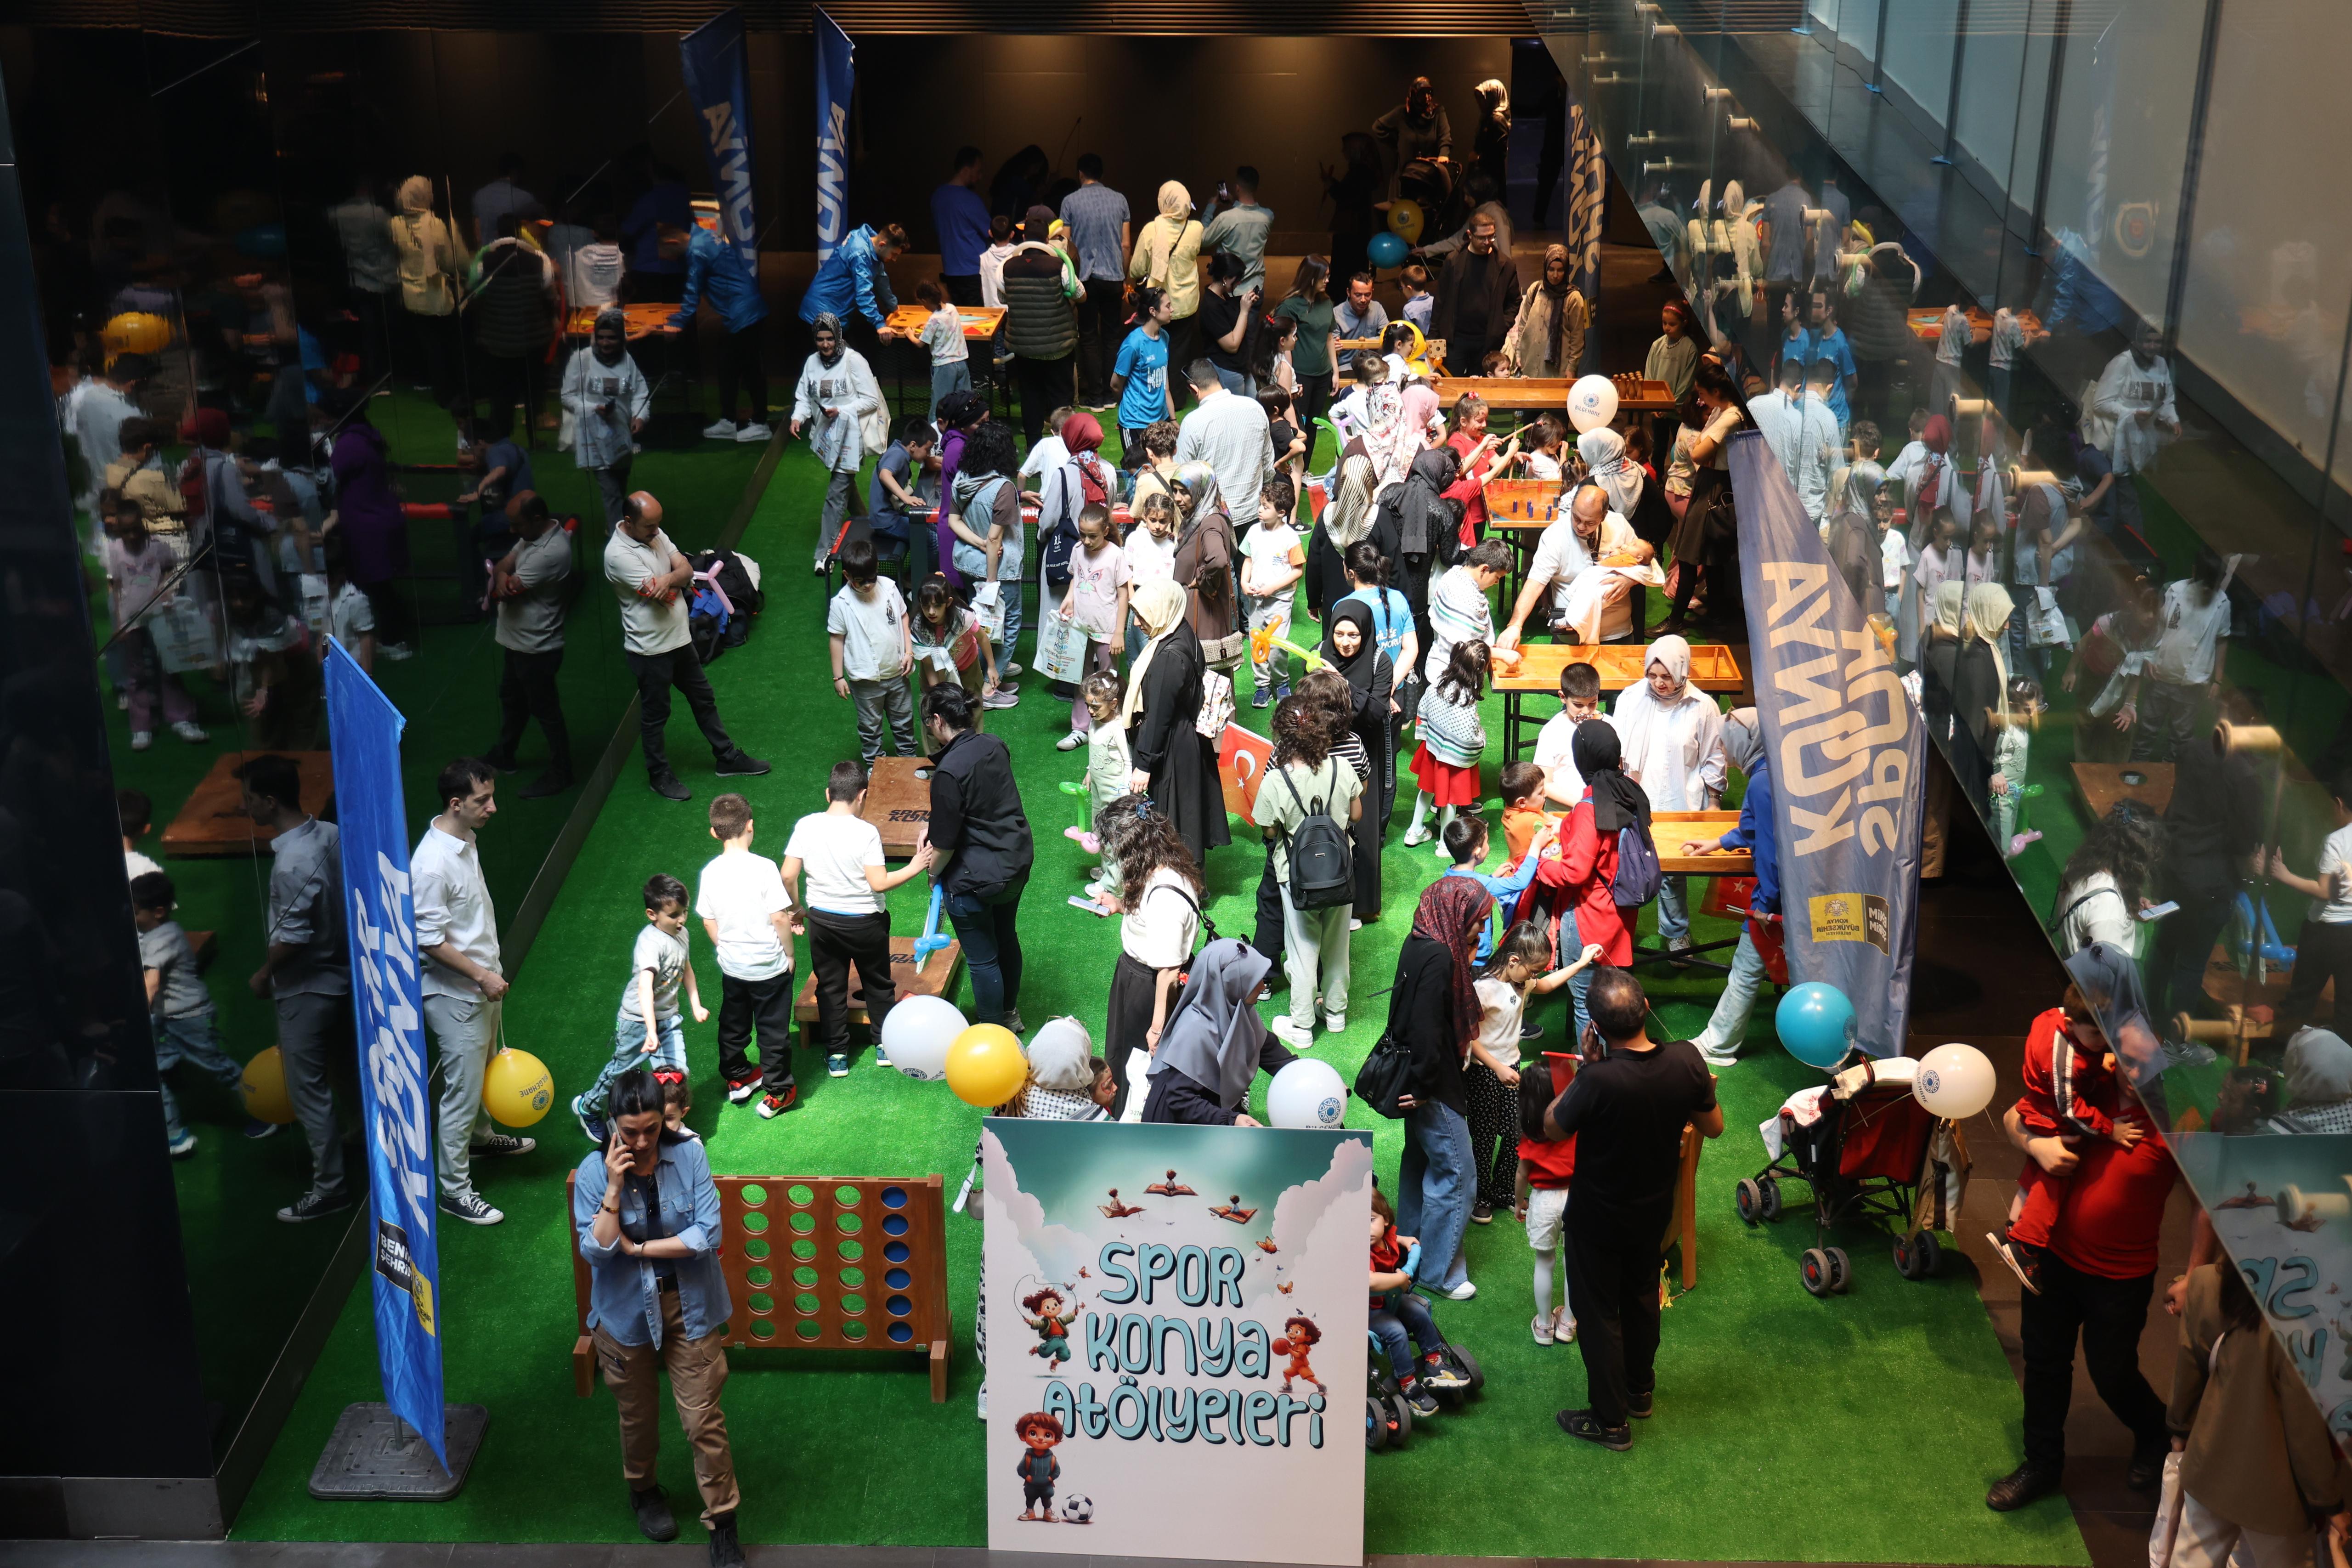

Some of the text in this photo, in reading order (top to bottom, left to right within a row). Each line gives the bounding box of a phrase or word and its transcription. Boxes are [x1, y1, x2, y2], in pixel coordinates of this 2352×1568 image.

[1575, 405, 1601, 417] BİLGEHANE
[889, 809, 932, 818] SPO
[1098, 1241, 1245, 1310] SPOR
